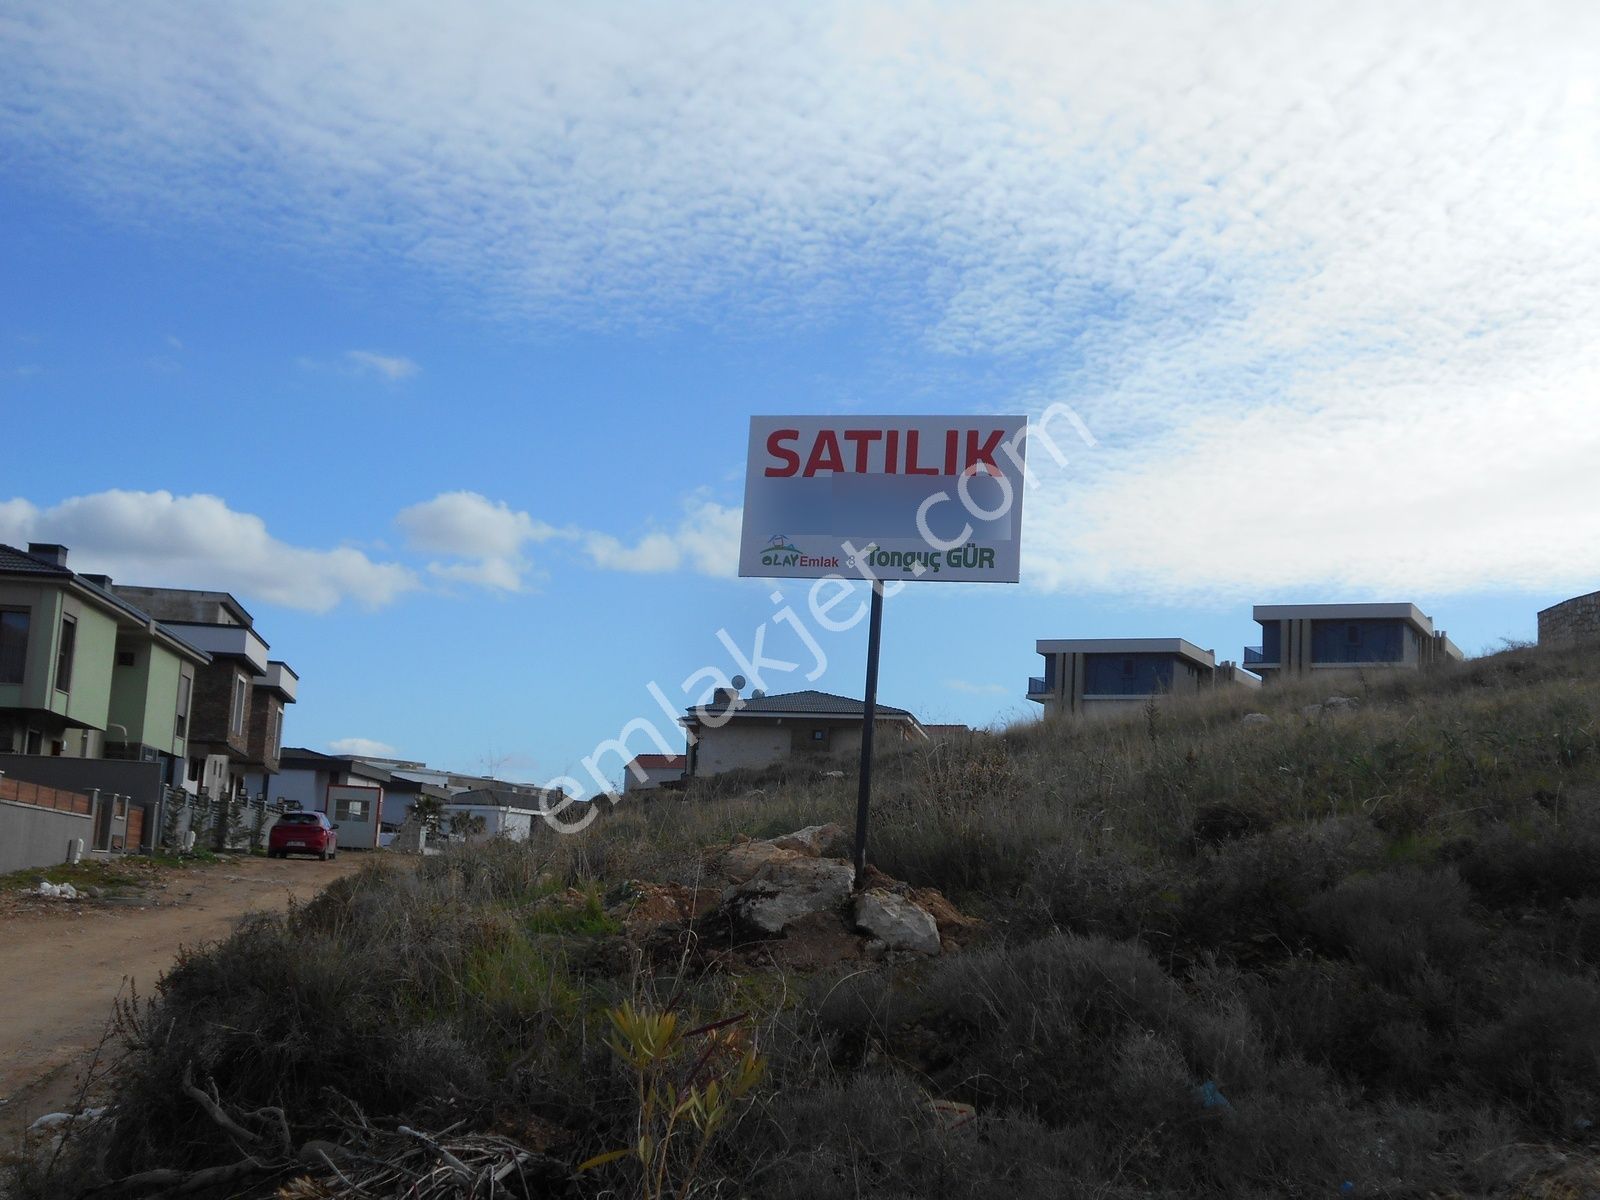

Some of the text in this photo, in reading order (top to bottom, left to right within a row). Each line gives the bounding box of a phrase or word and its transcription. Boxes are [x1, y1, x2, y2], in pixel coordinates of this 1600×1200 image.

[764, 429, 1005, 477] SATILIK
[866, 545, 941, 572] Tonguç
[947, 543, 995, 569] GÜR
